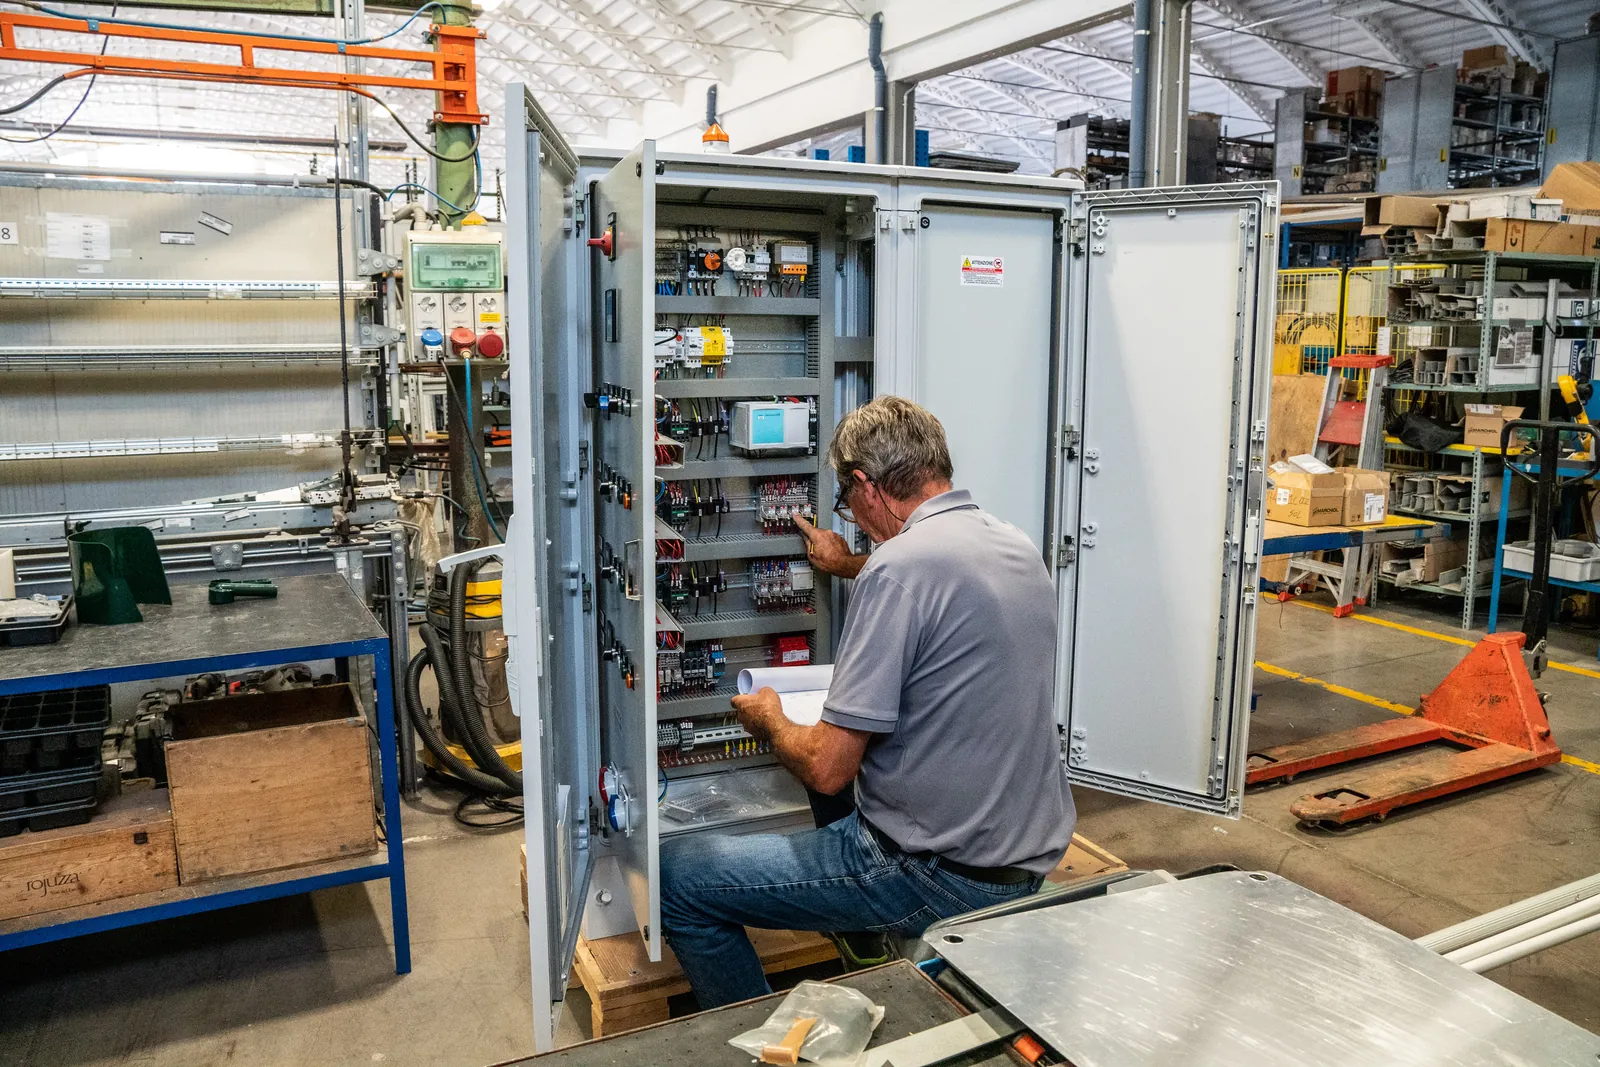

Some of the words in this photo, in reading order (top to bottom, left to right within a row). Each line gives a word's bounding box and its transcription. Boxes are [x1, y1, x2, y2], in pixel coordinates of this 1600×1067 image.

[1440, 149, 1446, 162] L
[1294, 167, 1300, 177] N
[1, 227, 11, 240] 8
[26, 872, 81, 898] rojuzza
